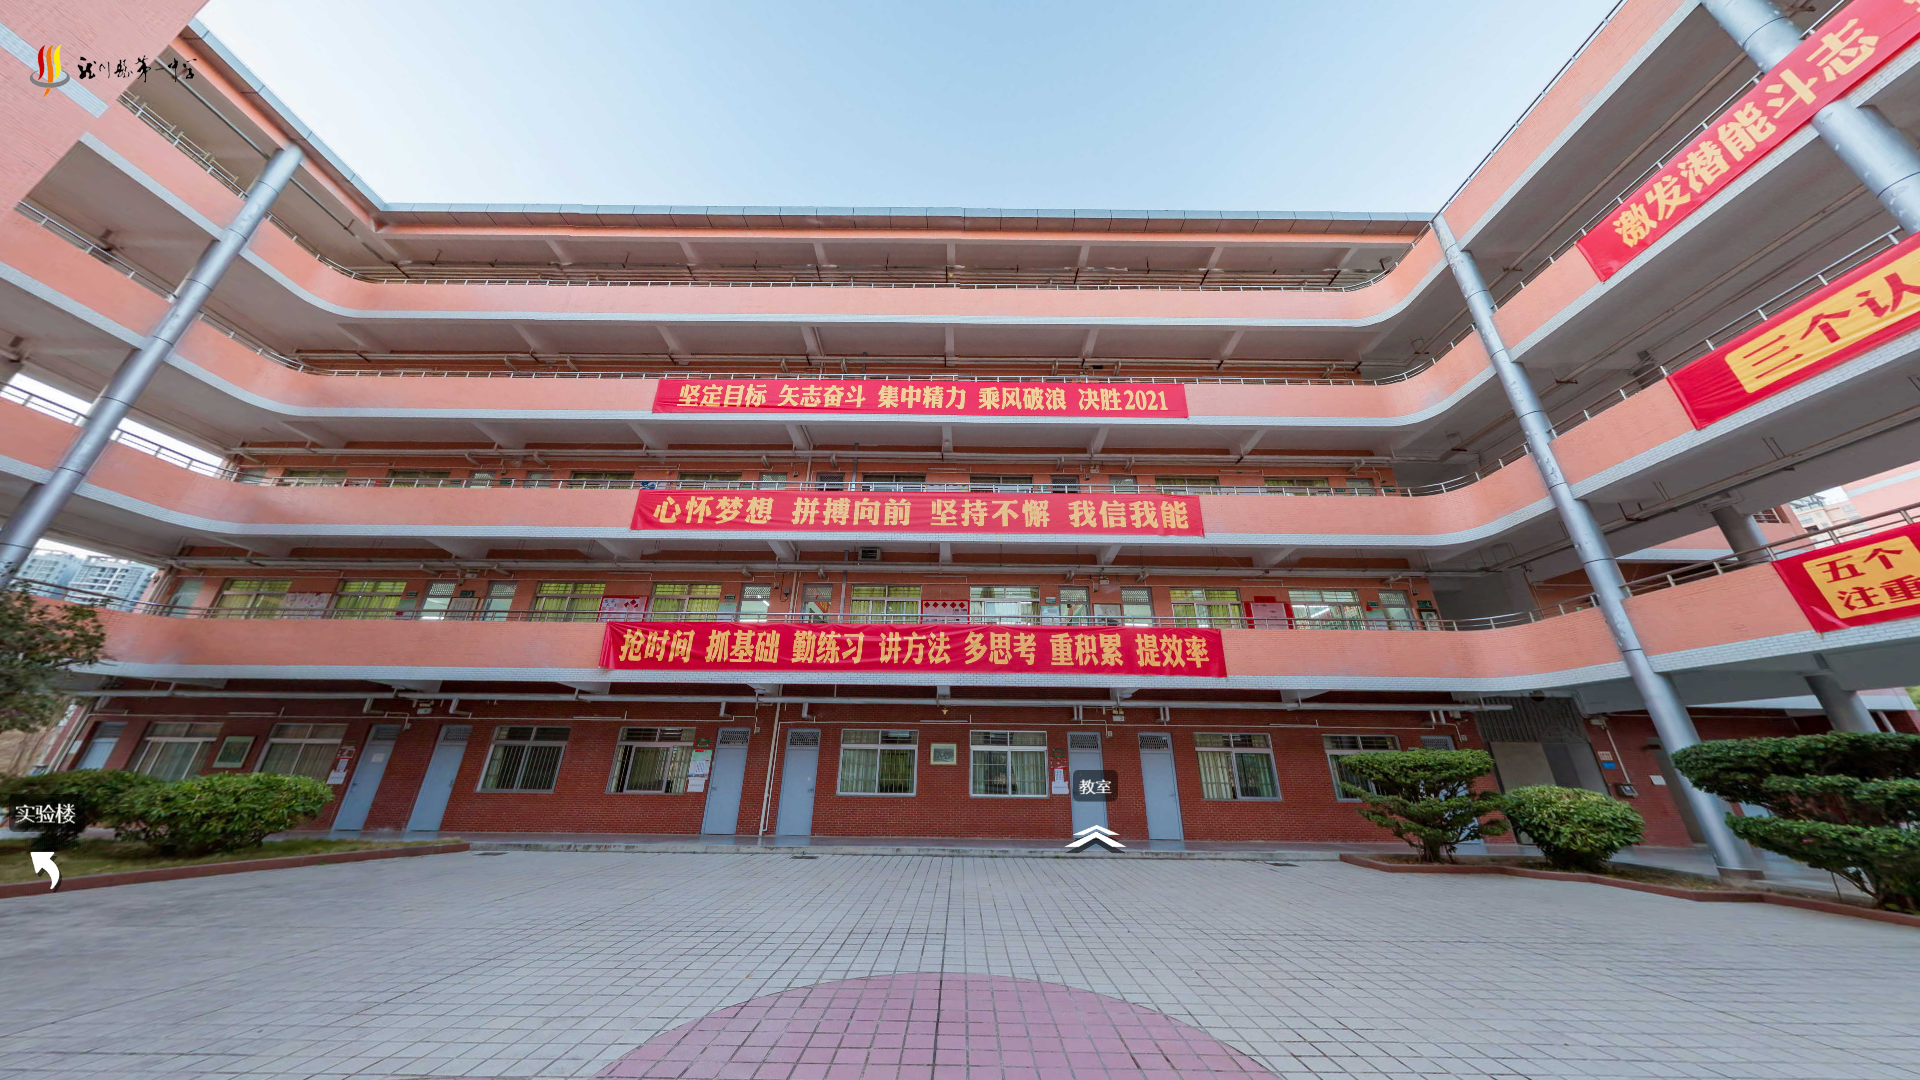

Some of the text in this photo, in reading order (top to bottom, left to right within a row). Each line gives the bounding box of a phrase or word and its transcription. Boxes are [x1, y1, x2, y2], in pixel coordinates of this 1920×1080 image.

[1612, 18, 1879, 247] 激发潜能斗志
[1742, 271, 1920, 379] 三个认
[677, 383, 1168, 412] 坚定目标 矢志奋斗 集中精力 乘风破浪 决胜2021
[653, 495, 1190, 530] 心怀梦想 拼搏向前 坚持不懈 我信我能
[1815, 547, 1904, 584] 五个
[1837, 574, 1920, 611] 注重
[618, 628, 1210, 669] 抢时间 抓基础 勤练习 讲方法 多思考 重积累 提效率
